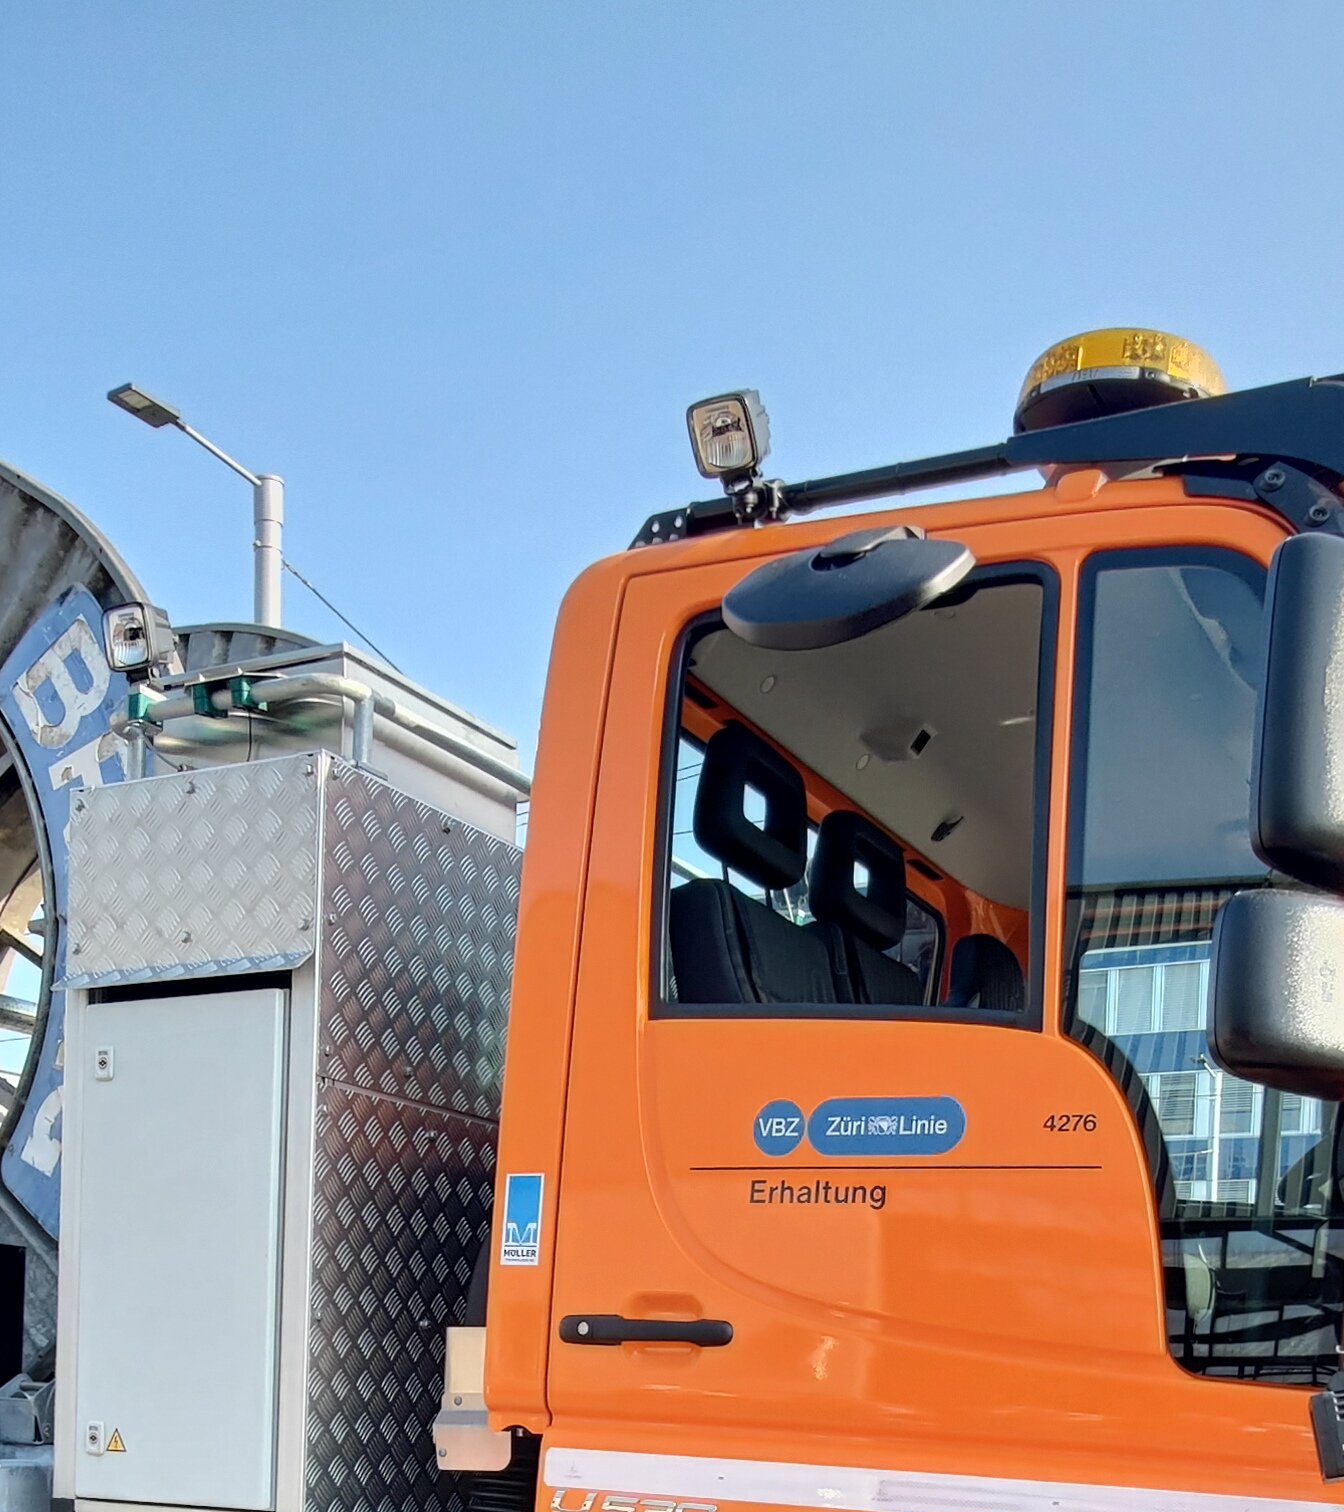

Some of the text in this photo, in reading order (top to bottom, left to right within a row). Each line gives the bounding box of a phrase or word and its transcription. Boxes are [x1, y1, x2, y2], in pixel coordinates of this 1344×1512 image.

[758, 1114, 948, 1137] VBZ Züri Linie
[1042, 1113, 1098, 1133] 4276
[748, 1179, 887, 1210] Erhaltung
